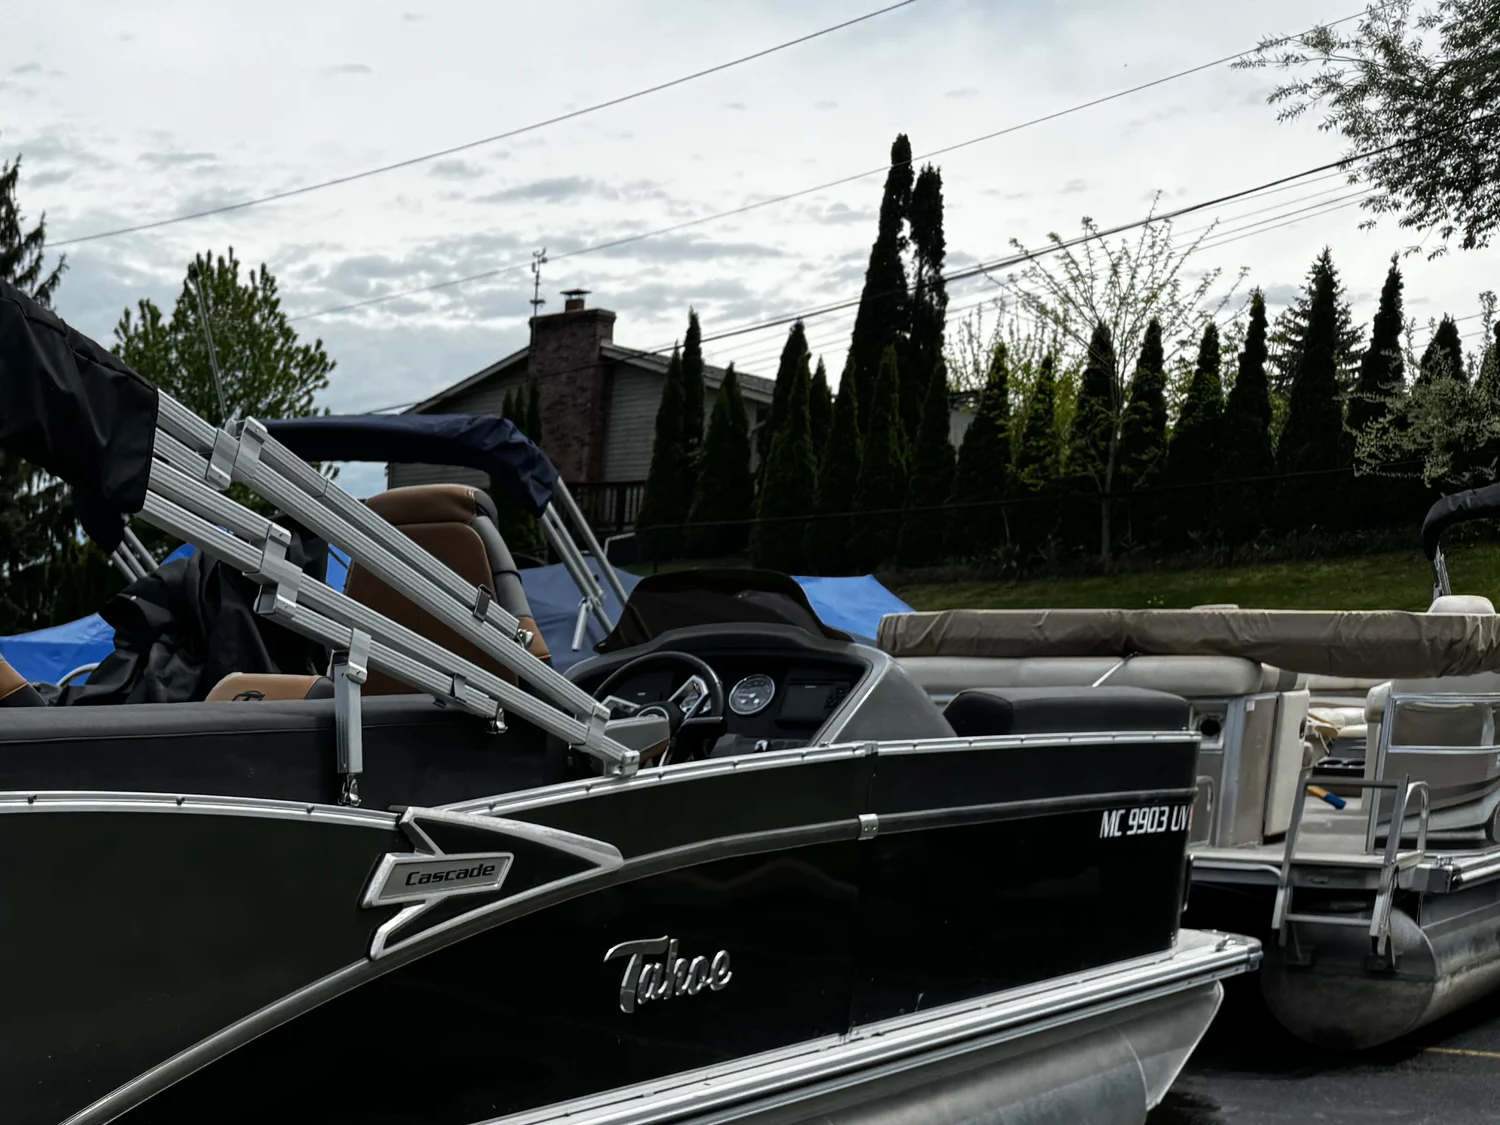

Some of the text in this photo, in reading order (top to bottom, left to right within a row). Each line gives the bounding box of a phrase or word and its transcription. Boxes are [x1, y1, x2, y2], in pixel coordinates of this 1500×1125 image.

[1099, 809, 1126, 839] MC
[1126, 805, 1169, 836] 9903
[405, 863, 496, 886] Cascade
[603, 935, 733, 1014] Tahoe
